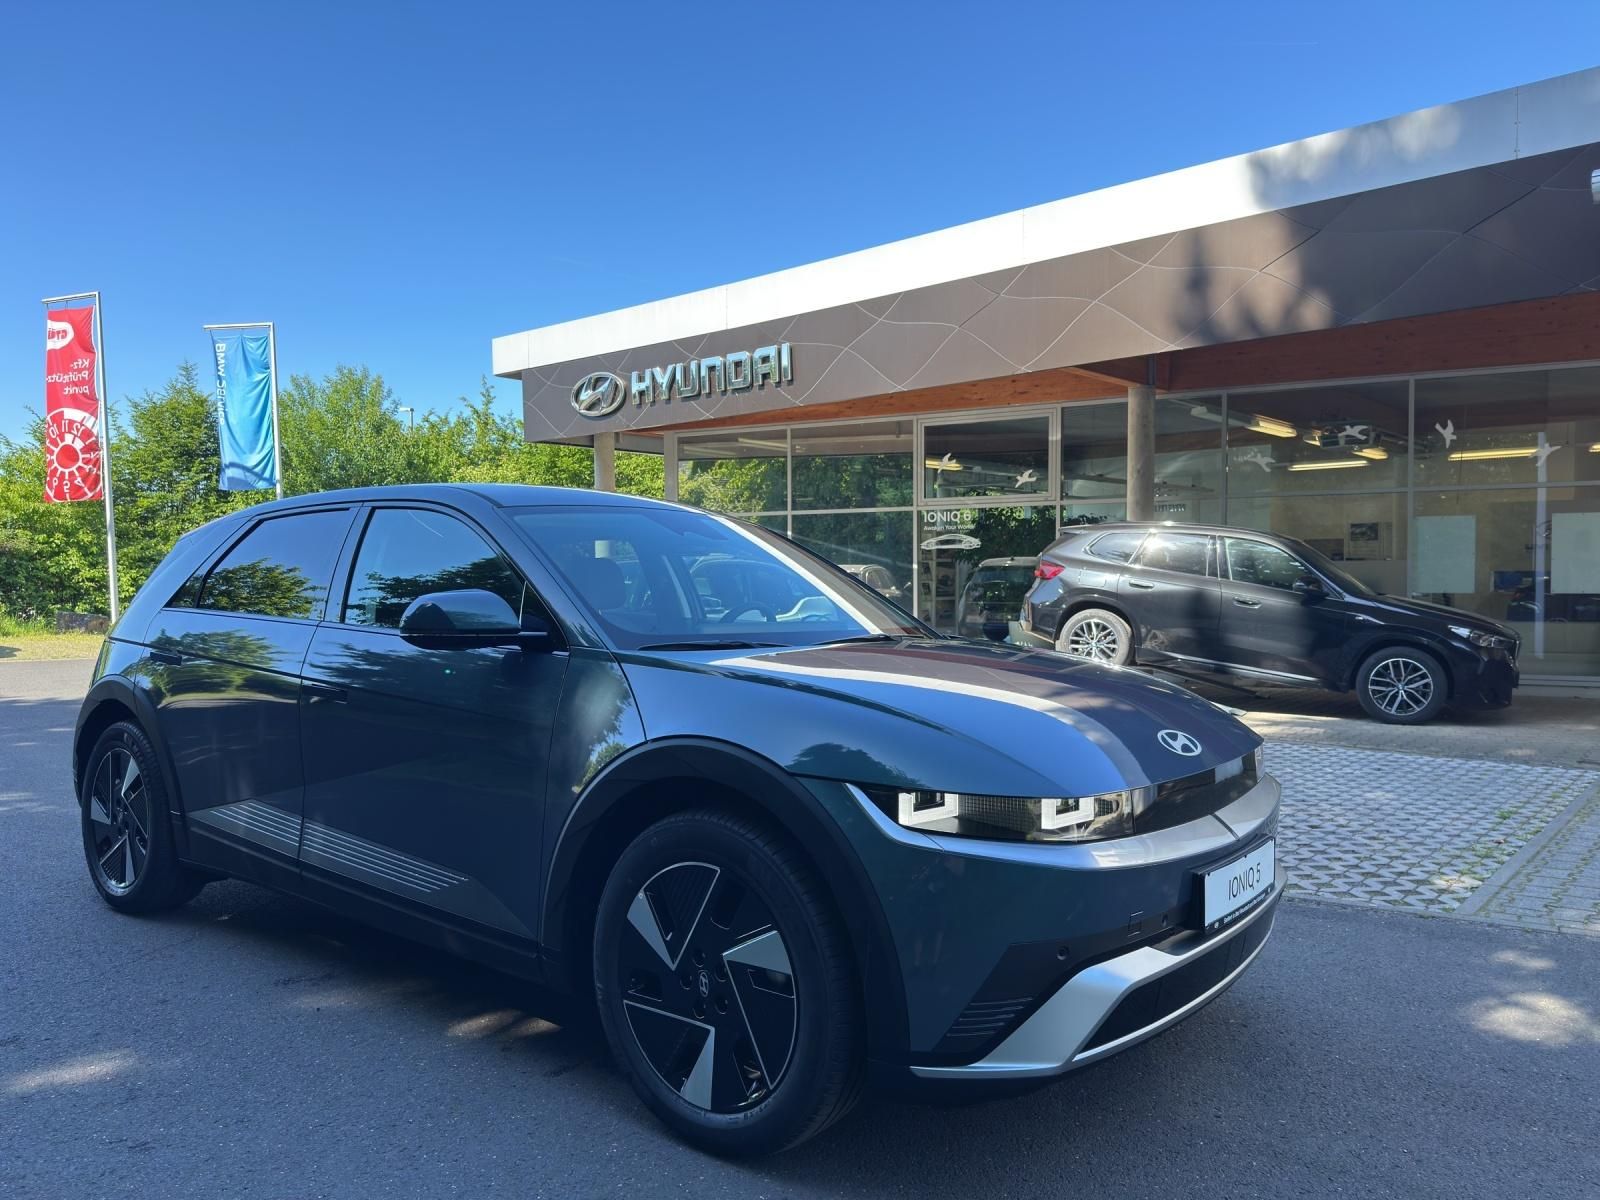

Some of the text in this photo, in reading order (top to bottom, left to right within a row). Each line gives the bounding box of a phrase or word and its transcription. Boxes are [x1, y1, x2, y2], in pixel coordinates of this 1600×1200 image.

[215, 343, 227, 425] BMW Service
[631, 342, 793, 406] HYUNDAI
[923, 510, 961, 523] IONIQ
[1229, 862, 1261, 900] IONIQ 5
